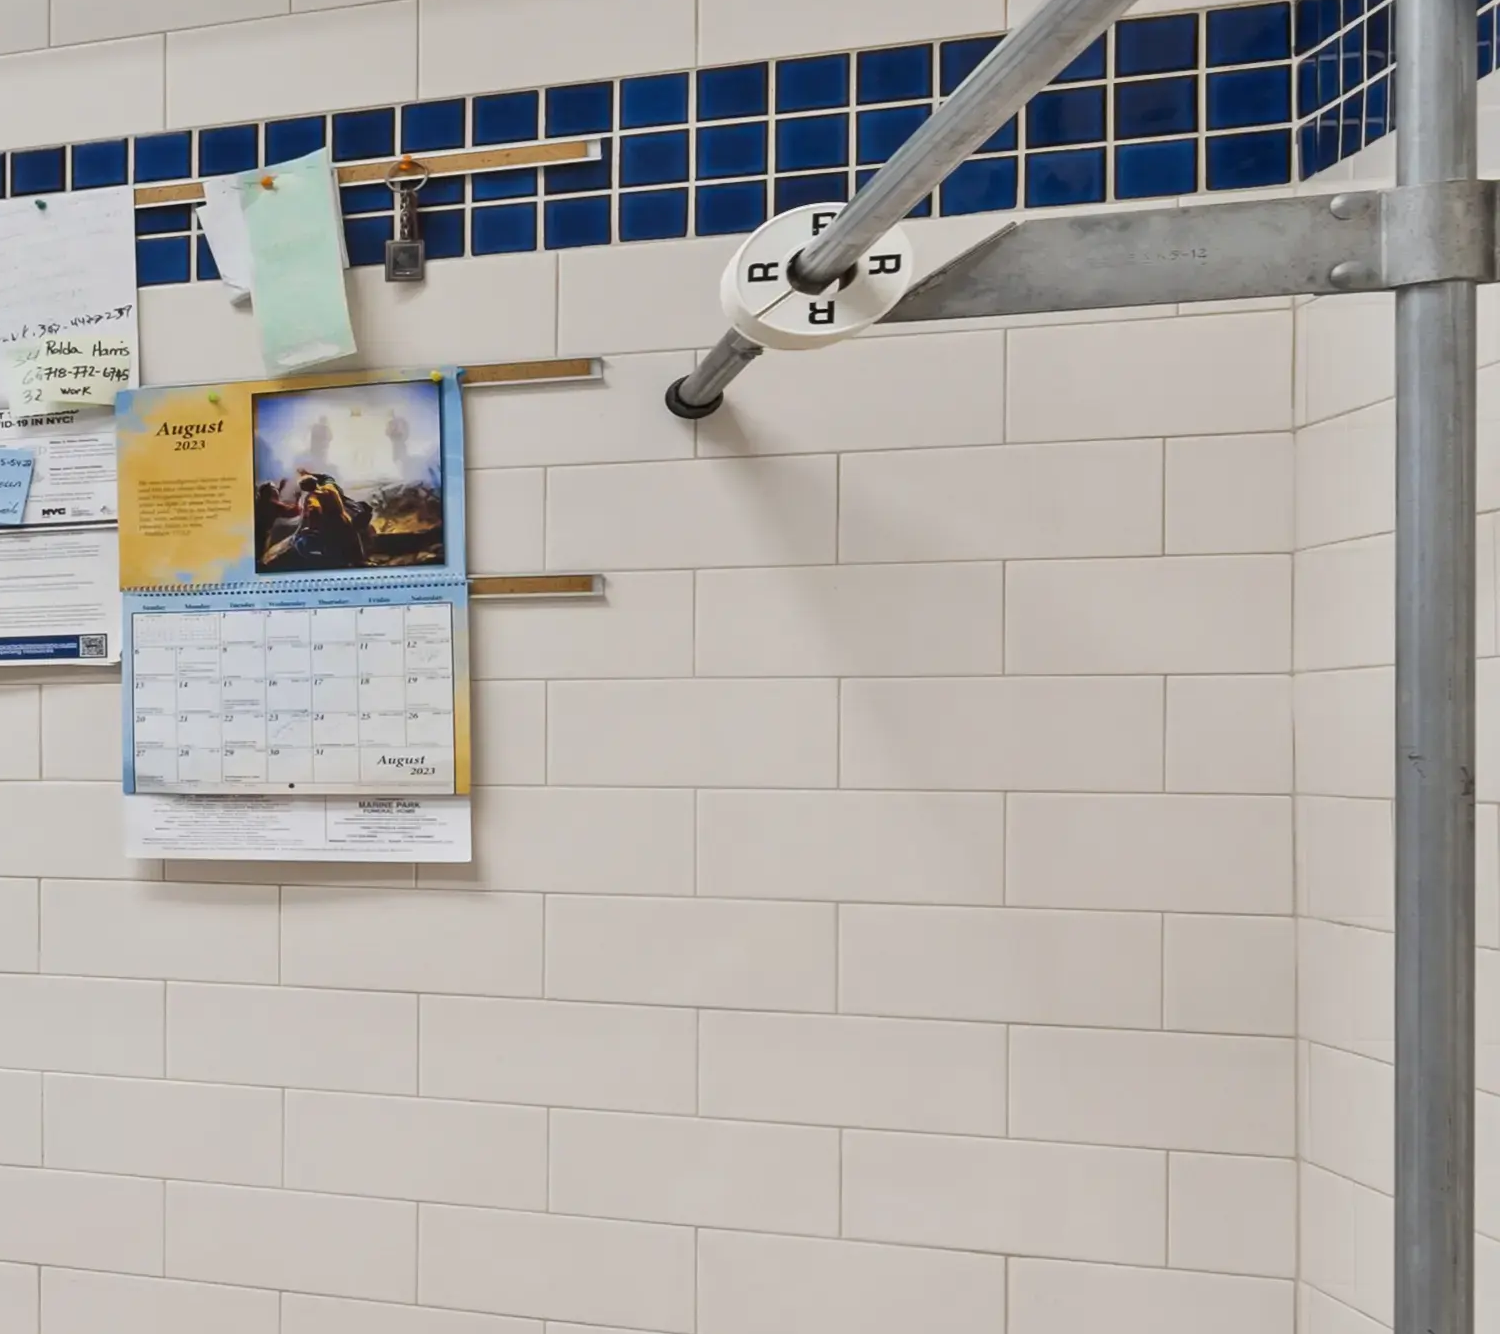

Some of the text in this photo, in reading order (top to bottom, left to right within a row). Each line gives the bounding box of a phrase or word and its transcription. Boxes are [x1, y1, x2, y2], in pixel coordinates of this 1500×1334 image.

[31, 418, 45, 427] IN
[155, 419, 225, 440] August
[174, 440, 206, 451] 2023
[376, 754, 427, 768] August
[410, 766, 437, 776] 2023
